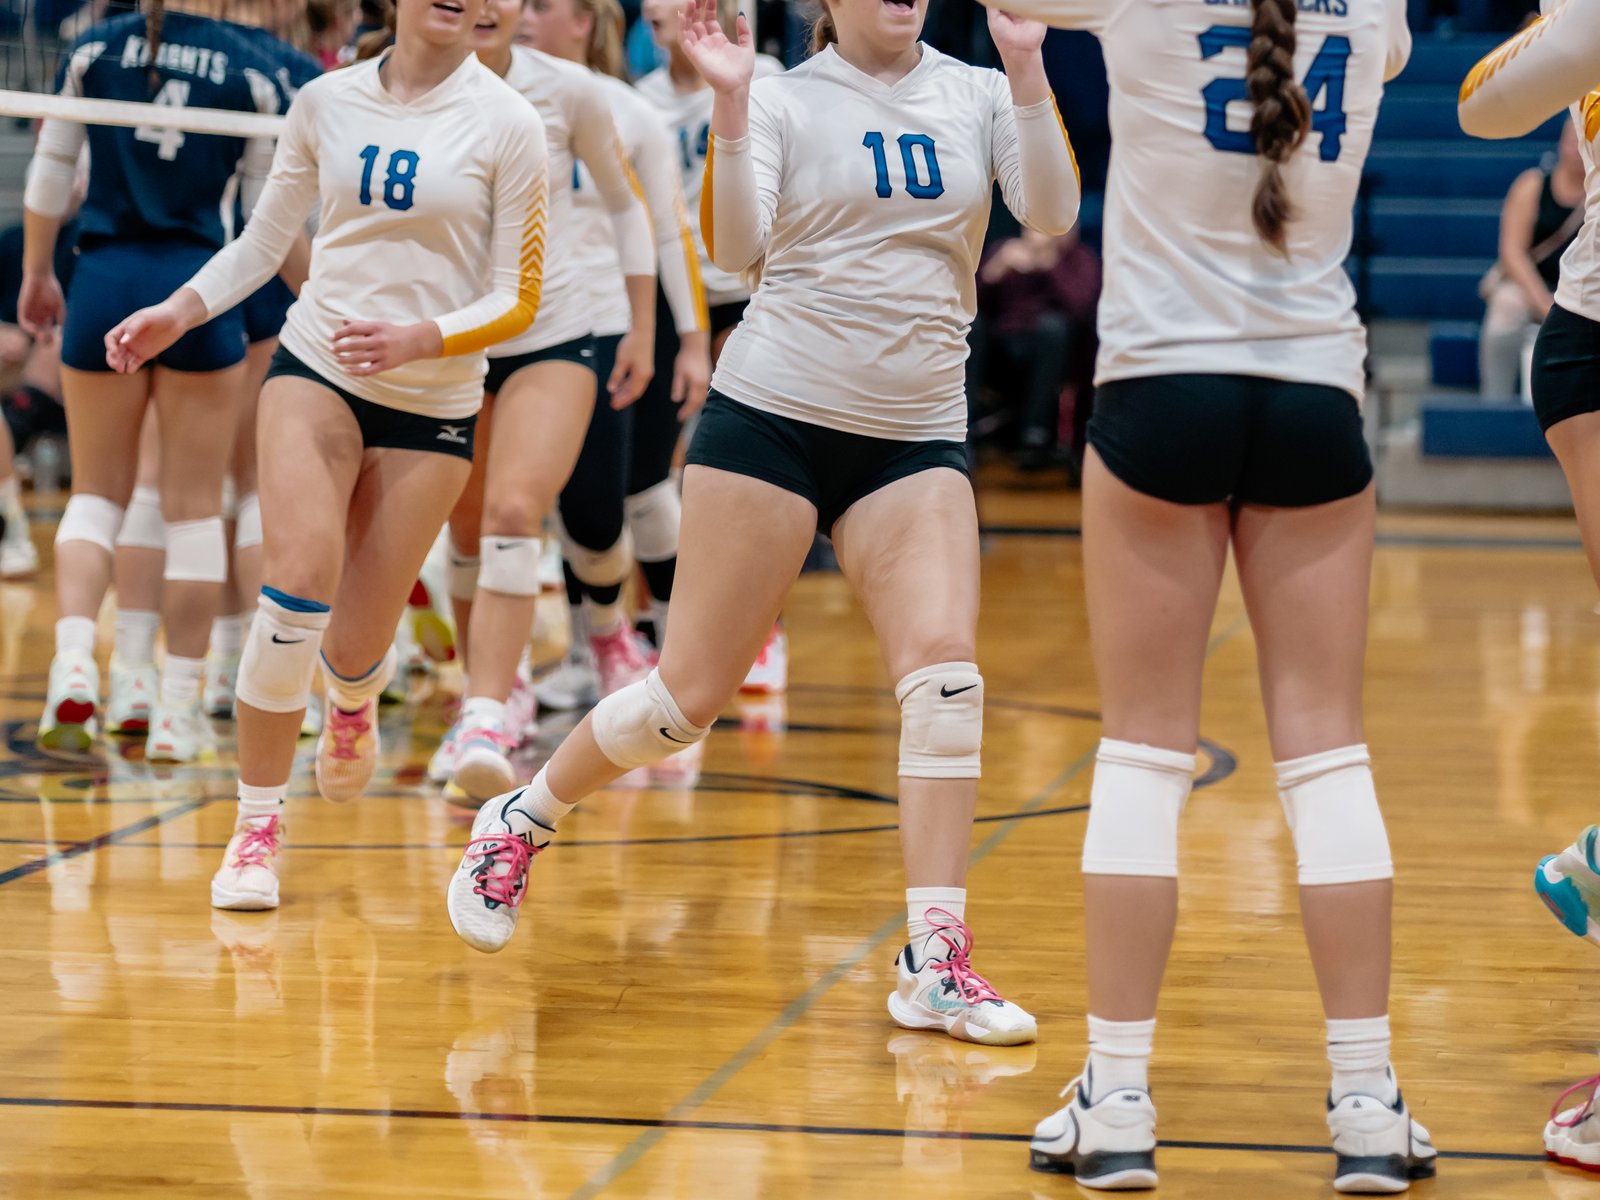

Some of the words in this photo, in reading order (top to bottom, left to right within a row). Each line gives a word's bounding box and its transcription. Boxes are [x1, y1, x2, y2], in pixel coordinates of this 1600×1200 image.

[134, 78, 191, 161] 4
[1196, 24, 1352, 162] 24
[359, 145, 420, 211] 18
[862, 131, 945, 199] 10
